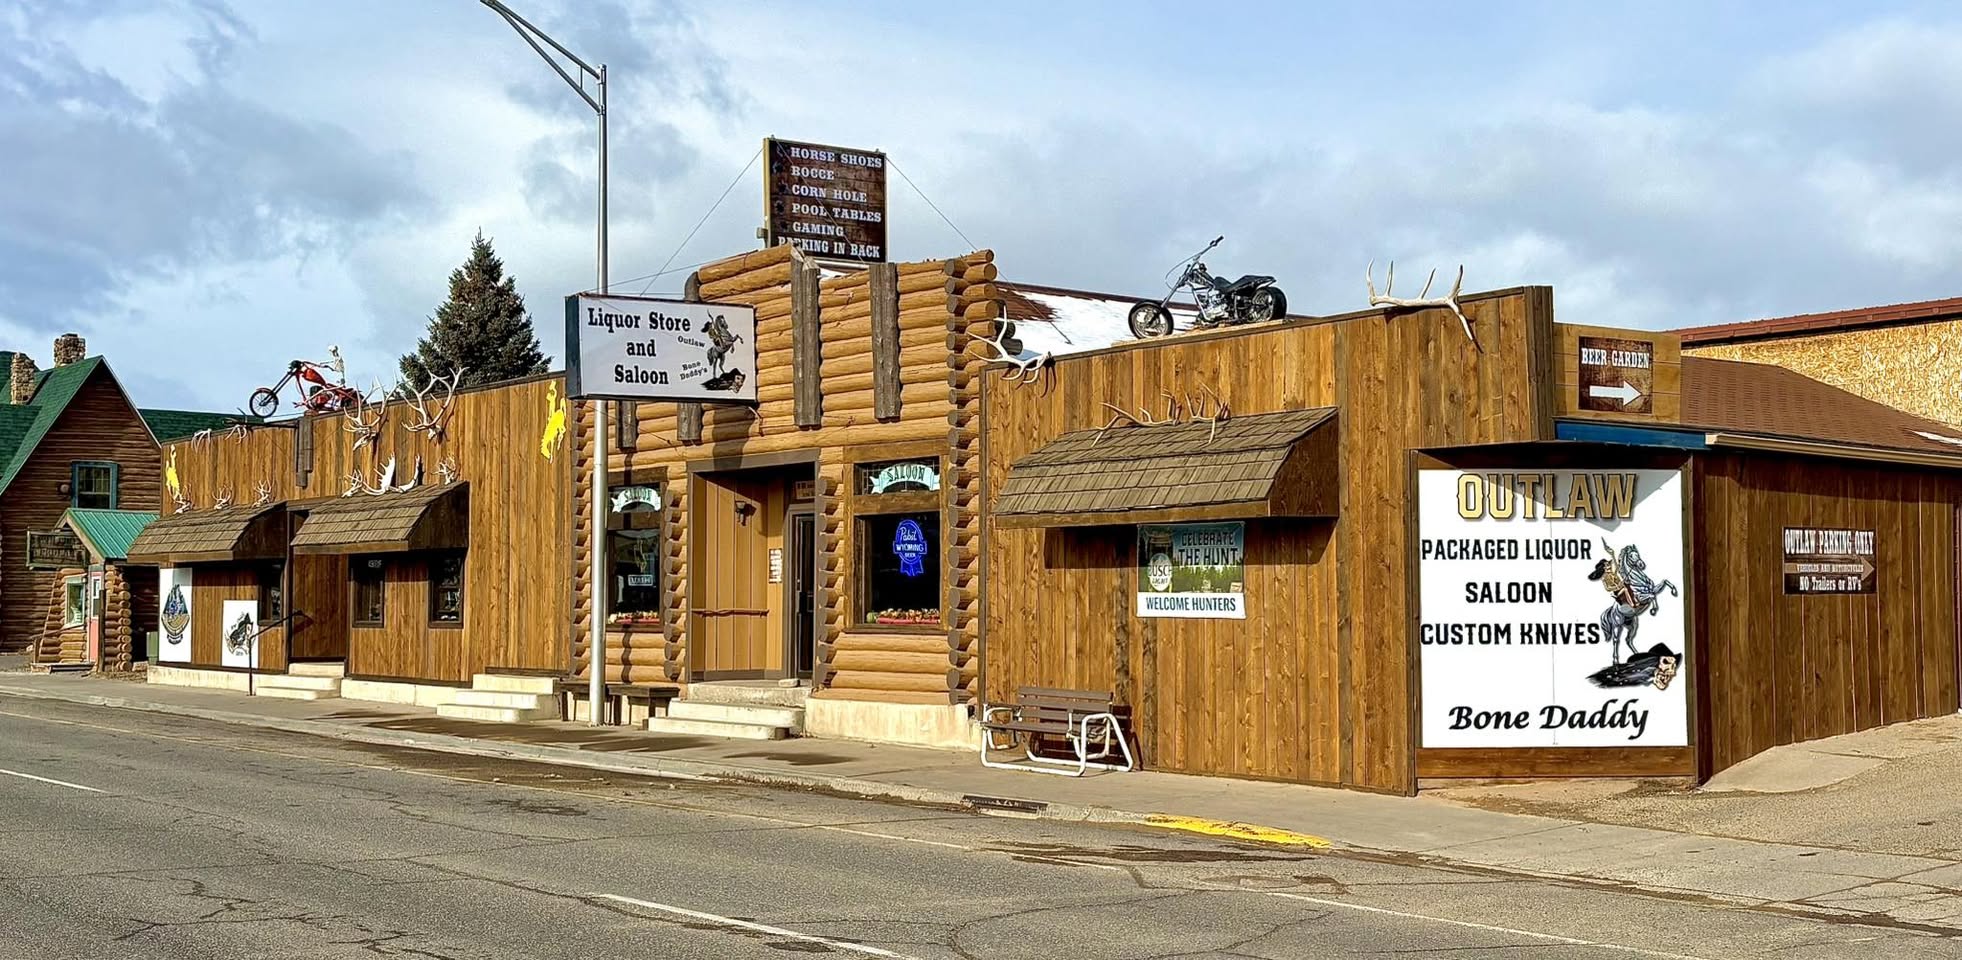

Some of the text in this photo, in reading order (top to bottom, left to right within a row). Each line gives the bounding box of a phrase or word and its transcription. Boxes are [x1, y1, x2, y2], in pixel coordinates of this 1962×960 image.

[790, 146, 882, 168] HORSE SHOES
[790, 165, 835, 181] BOCCE
[791, 184, 867, 203] CORN HOLE
[791, 203, 882, 223] POOL TABLES
[792, 221, 844, 237] GAMING
[833, 241, 846, 255] IN
[850, 243, 880, 258] BACK
[588, 307, 691, 333] Liquor Store
[626, 339, 657, 357] and
[677, 335, 706, 348] Outlaw
[682, 361, 702, 371] Bone
[1581, 347, 1650, 369] BEER GARDEN
[614, 364, 669, 385] Saloon
[887, 463, 926, 482] SALOON
[1456, 473, 1638, 519] OUTLAW
[900, 526, 917, 544] Pabst
[1181, 531, 1234, 547] CELEBRATE
[1785, 529, 1874, 555] OUTLAW PARKING ONLY
[895, 543, 924, 552] WYOMING
[1178, 548, 1238, 566] THE HUNT
[1421, 538, 1592, 560] PACKAGED LIQUOR
[1465, 581, 1553, 604] SALOON
[1799, 576, 1810, 591] NO
[1811, 575, 1836, 591] Trailers
[1838, 579, 1846, 591] or
[1146, 597, 1236, 611] WELCOME HUNTERS
[1420, 623, 1601, 645] CUSTOM KNIVES
[1448, 699, 1649, 741] Bone Daddy
